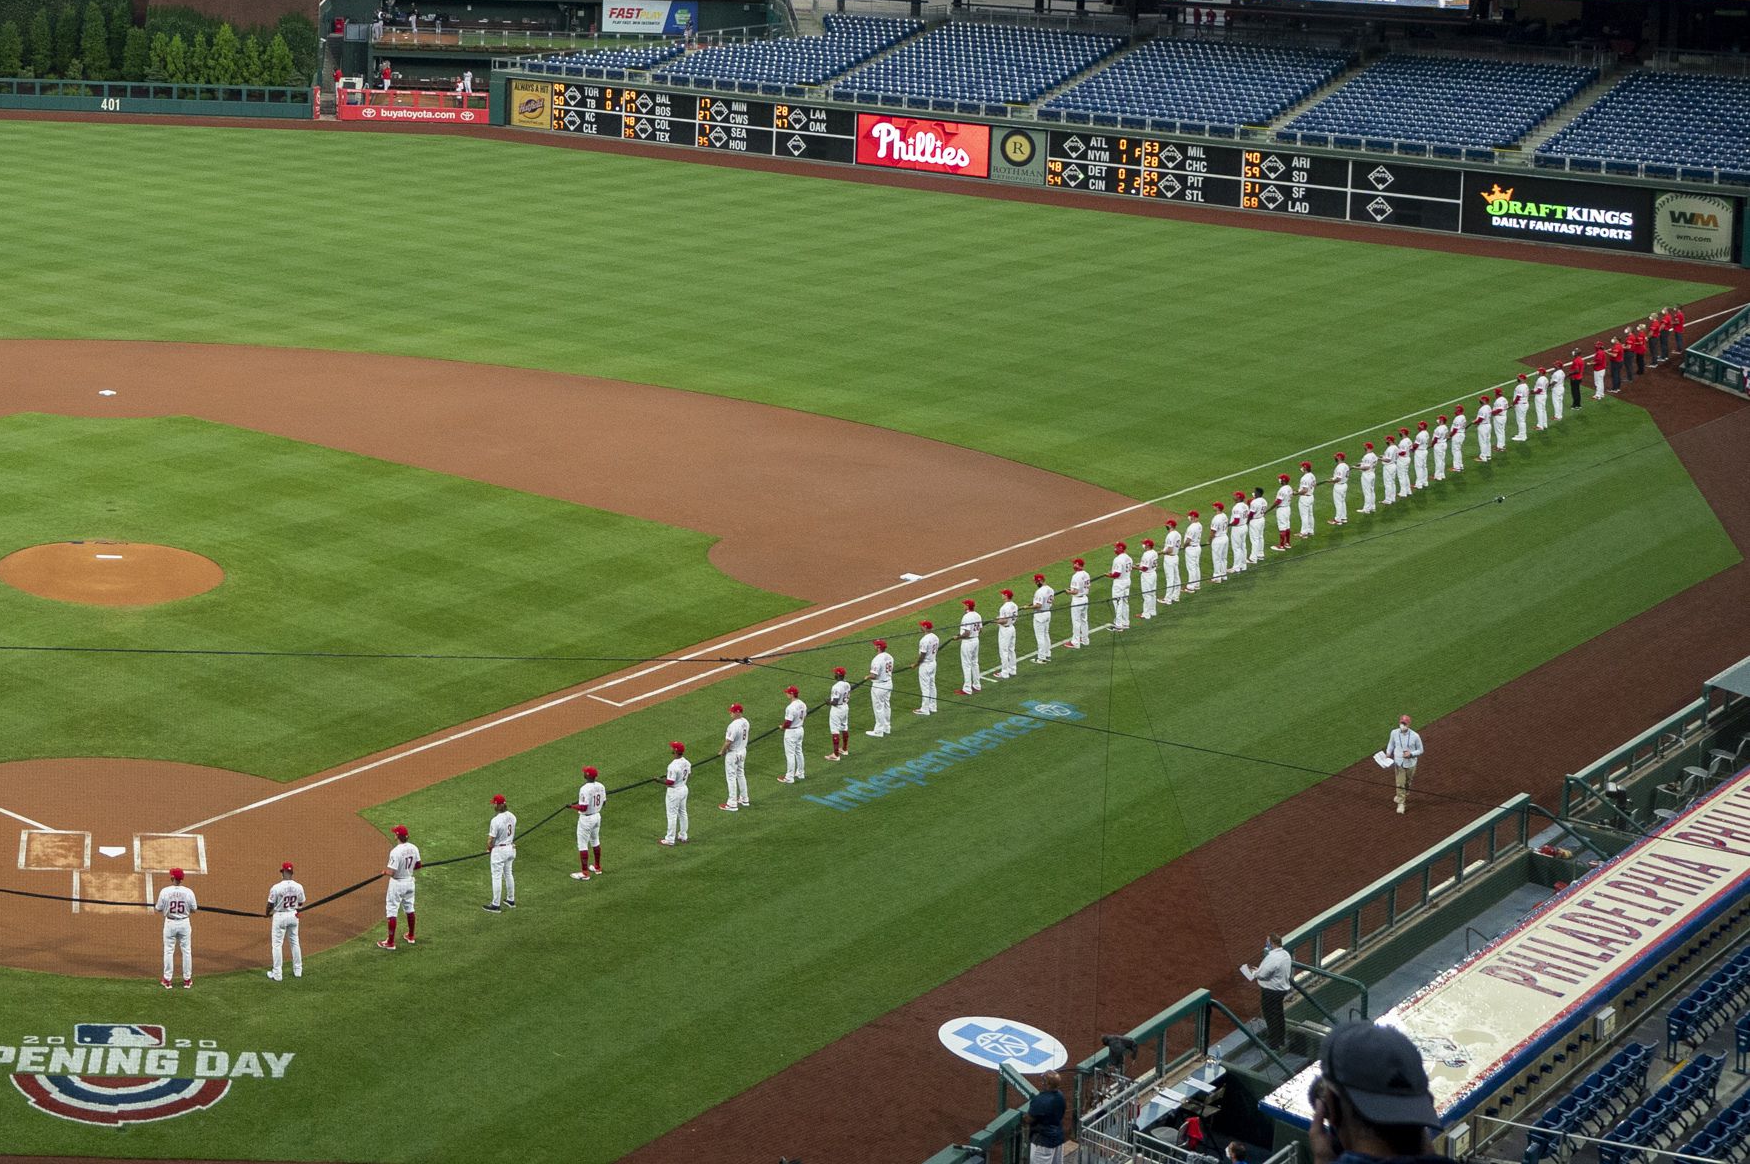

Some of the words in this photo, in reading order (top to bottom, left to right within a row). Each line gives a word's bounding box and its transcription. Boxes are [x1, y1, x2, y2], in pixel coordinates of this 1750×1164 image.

[514, 82, 535, 92] ALWAYS
[539, 85, 549, 93] HIT
[584, 86, 599, 97] TOR
[586, 98, 596, 109] TB
[655, 93, 671, 104] BAL
[655, 106, 671, 117] BOS
[731, 101, 747, 112] MIN
[381, 108, 456, 120] buyatoyota.com
[585, 111, 596, 122] KC
[729, 113, 748, 125] CWS
[810, 109, 826, 121] LAA
[583, 123, 597, 134] CLE
[655, 119, 671, 130] COL
[809, 121, 827, 133] OAK
[655, 131, 670, 142] TEX
[731, 127, 747, 139] SEA
[729, 139, 747, 151] HOU
[872, 122, 969, 167] Phillies
[1013, 141, 1025, 154] R
[1090, 137, 1108, 148] ATL
[1088, 150, 1110, 162] NYM
[1188, 146, 1206, 158] MIL
[1186, 160, 1207, 173] CHC
[1291, 156, 1310, 169] ARI
[992, 165, 1043, 178] ROTHMAN
[1088, 165, 1107, 177] DET
[1292, 171, 1307, 183] SD
[1088, 179, 1106, 191] CIN
[1188, 176, 1204, 188] PIT
[1185, 190, 1205, 202] STL
[1292, 186, 1306, 198] SF
[1288, 200, 1310, 214] LAD
[1486, 199, 1633, 226] DRAFTKINGS
[1669, 210, 1719, 228] WM
[1492, 215, 1527, 230] DAILY
[1529, 220, 1582, 235] FANTASY
[1585, 226, 1632, 240] SPORTS
[1676, 235, 1712, 243] wm.com
[803, 709, 1046, 811] Independence
[593, 794, 601, 807] 18
[404, 855, 413, 870] 17
[169, 900, 185, 914] 25
[283, 895, 297, 909] 22
[1479, 851, 1731, 999] PHILADELPHIA
[194, 1049, 295, 1079] DAY
